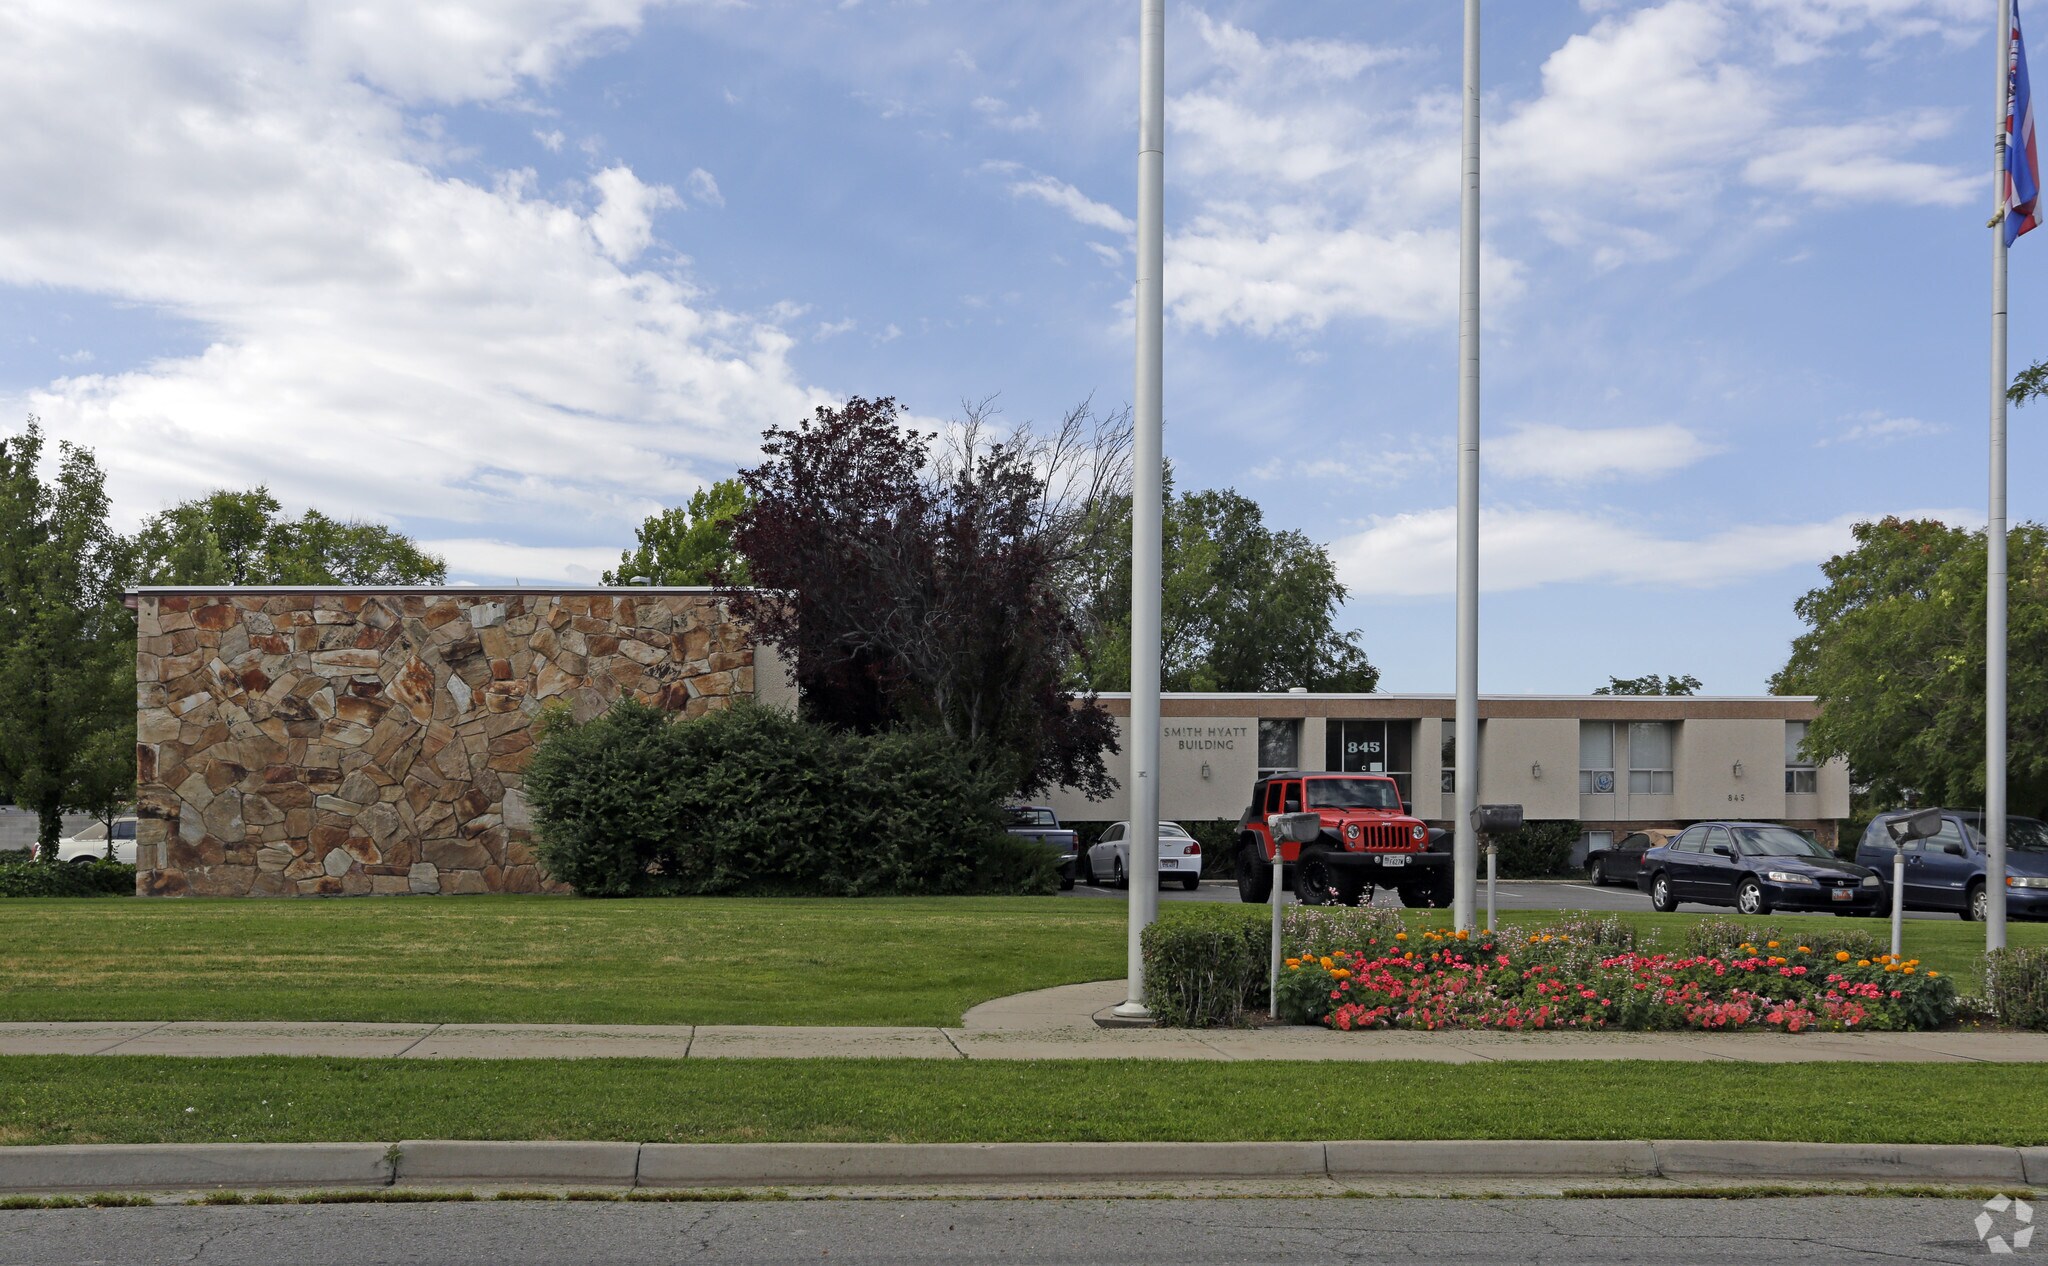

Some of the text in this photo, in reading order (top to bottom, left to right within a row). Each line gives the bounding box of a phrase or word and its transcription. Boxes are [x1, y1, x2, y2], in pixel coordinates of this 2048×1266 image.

[1163, 727, 1247, 737] SMITH HYATT
[1178, 740, 1234, 750] BUILDING
[1347, 741, 1381, 753] 845
[1727, 794, 1745, 802] 845
